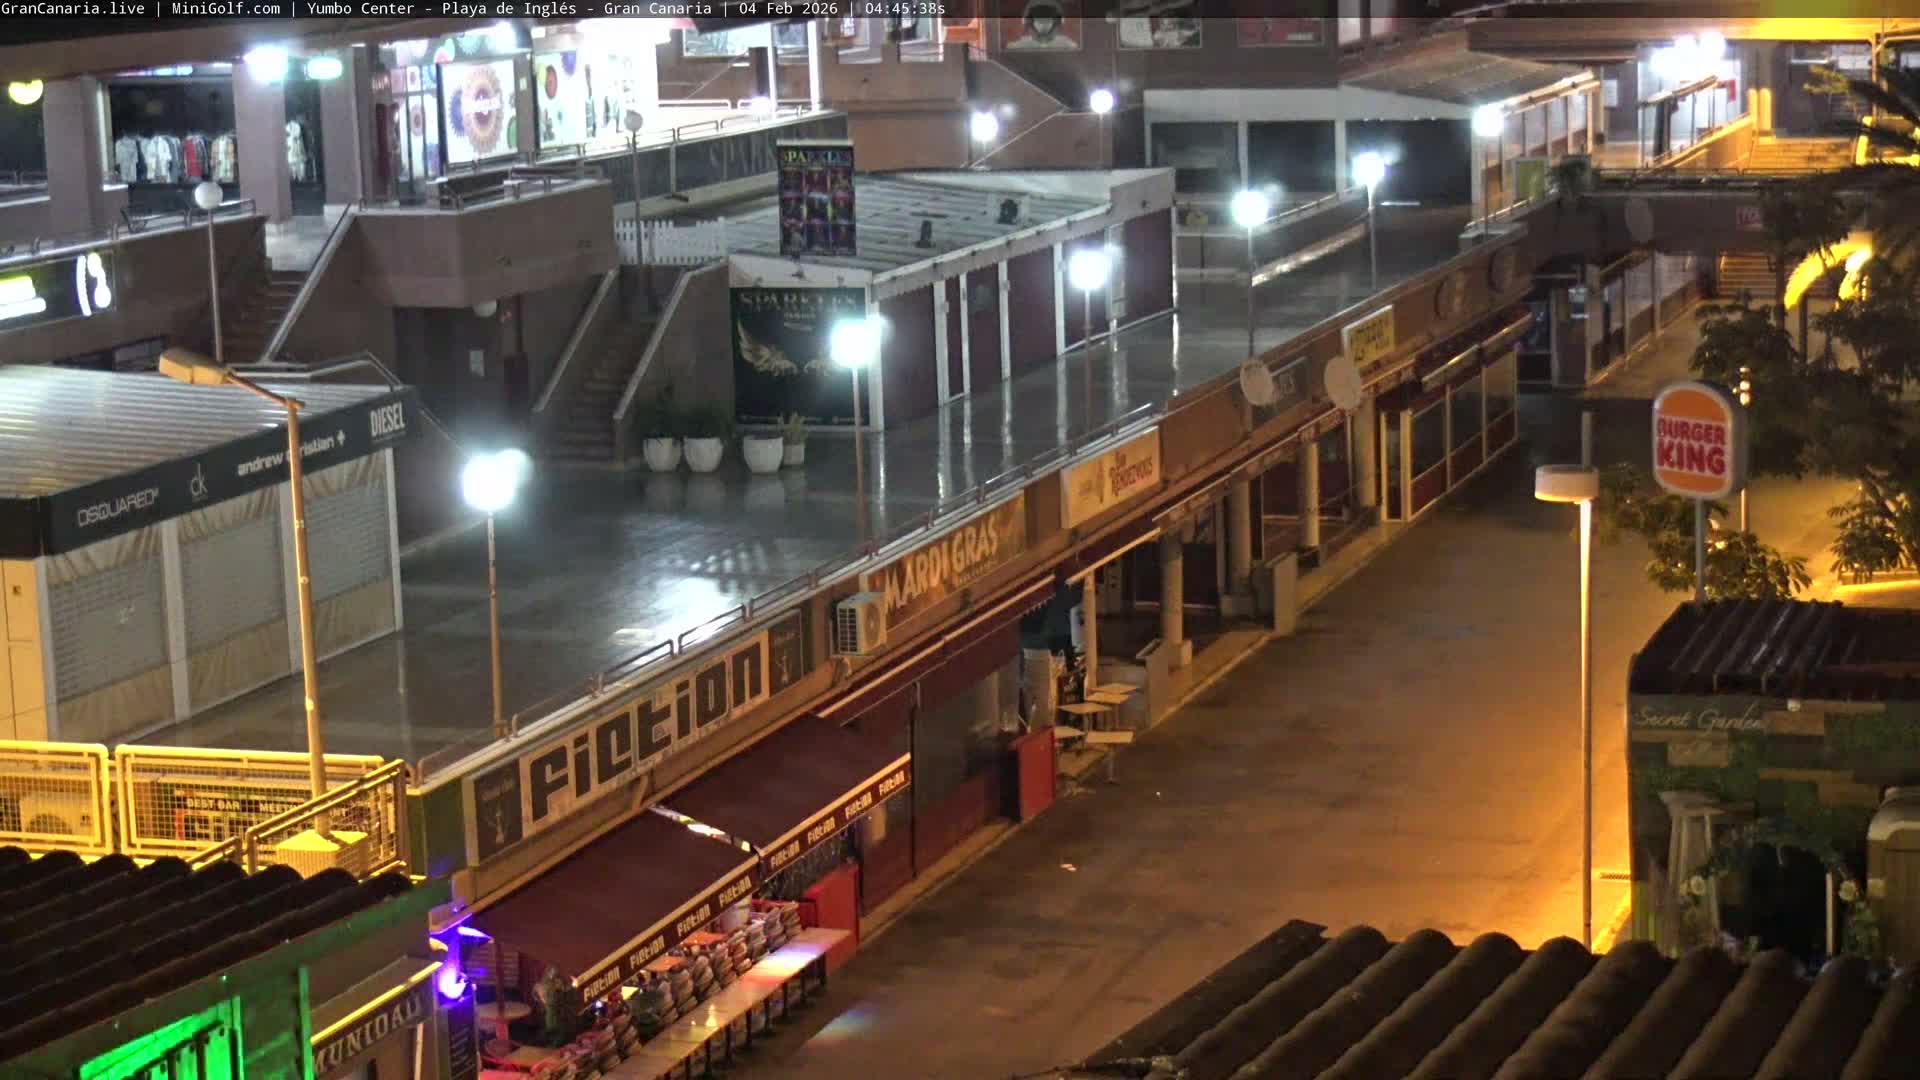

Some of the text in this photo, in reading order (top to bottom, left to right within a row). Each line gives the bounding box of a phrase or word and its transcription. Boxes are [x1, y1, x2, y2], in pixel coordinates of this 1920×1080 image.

[370, 401, 405, 437] DIESEL
[1657, 418, 1726, 446] BURGER
[237, 453, 284, 477] andrew
[1656, 438, 1726, 475] KING
[877, 539, 951, 622] MARDI
[951, 514, 998, 573] GRAS
[1633, 706, 1692, 729] Secret
